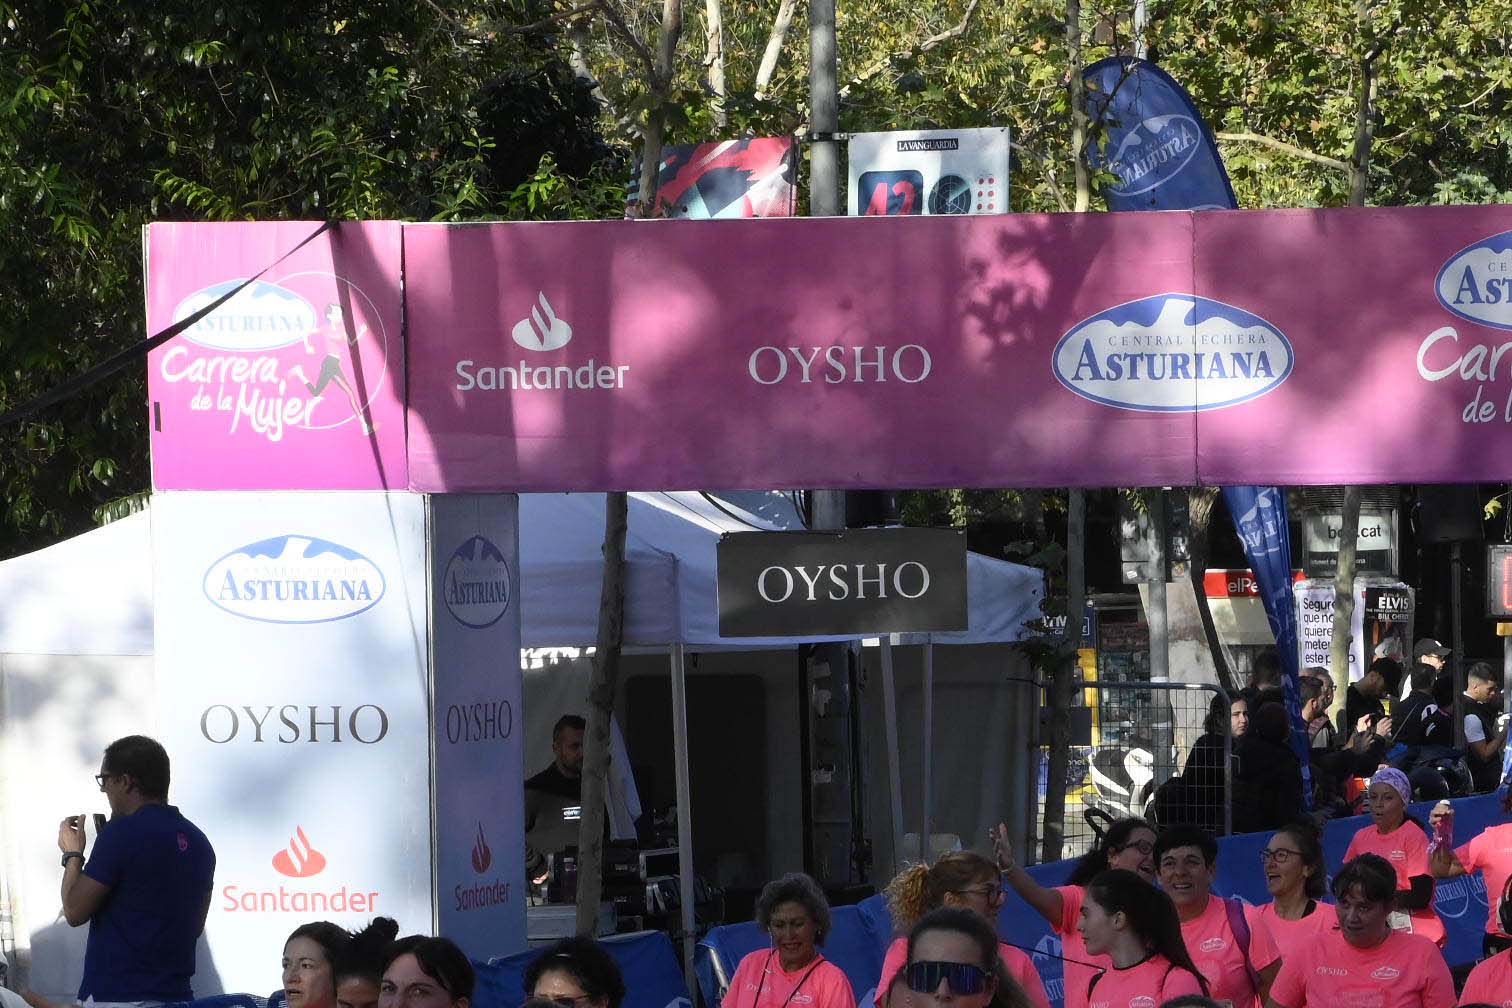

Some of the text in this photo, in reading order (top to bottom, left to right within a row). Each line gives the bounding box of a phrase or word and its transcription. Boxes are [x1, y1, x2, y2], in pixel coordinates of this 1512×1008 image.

[1108, 333, 1267, 348] CENTRAL LECHERA
[161, 346, 279, 383] Carrera
[456, 358, 630, 391] Santander
[748, 344, 932, 384] OYSHO
[1072, 338, 1275, 382] ASTURIANA
[191, 381, 323, 441] de la Mujer
[1462, 386, 1496, 423] de
[218, 568, 373, 601] ASTURIANA
[448, 571, 506, 605] ASTURIANA
[758, 562, 930, 603] OYSHO
[1304, 613, 1320, 624] que
[1379, 597, 1408, 610] ELVIS
[1305, 654, 1323, 664] este
[200, 704, 389, 744] OYSHO
[446, 700, 512, 744] OYSHO
[223, 886, 379, 912] Santander
[455, 881, 510, 912] Santander
